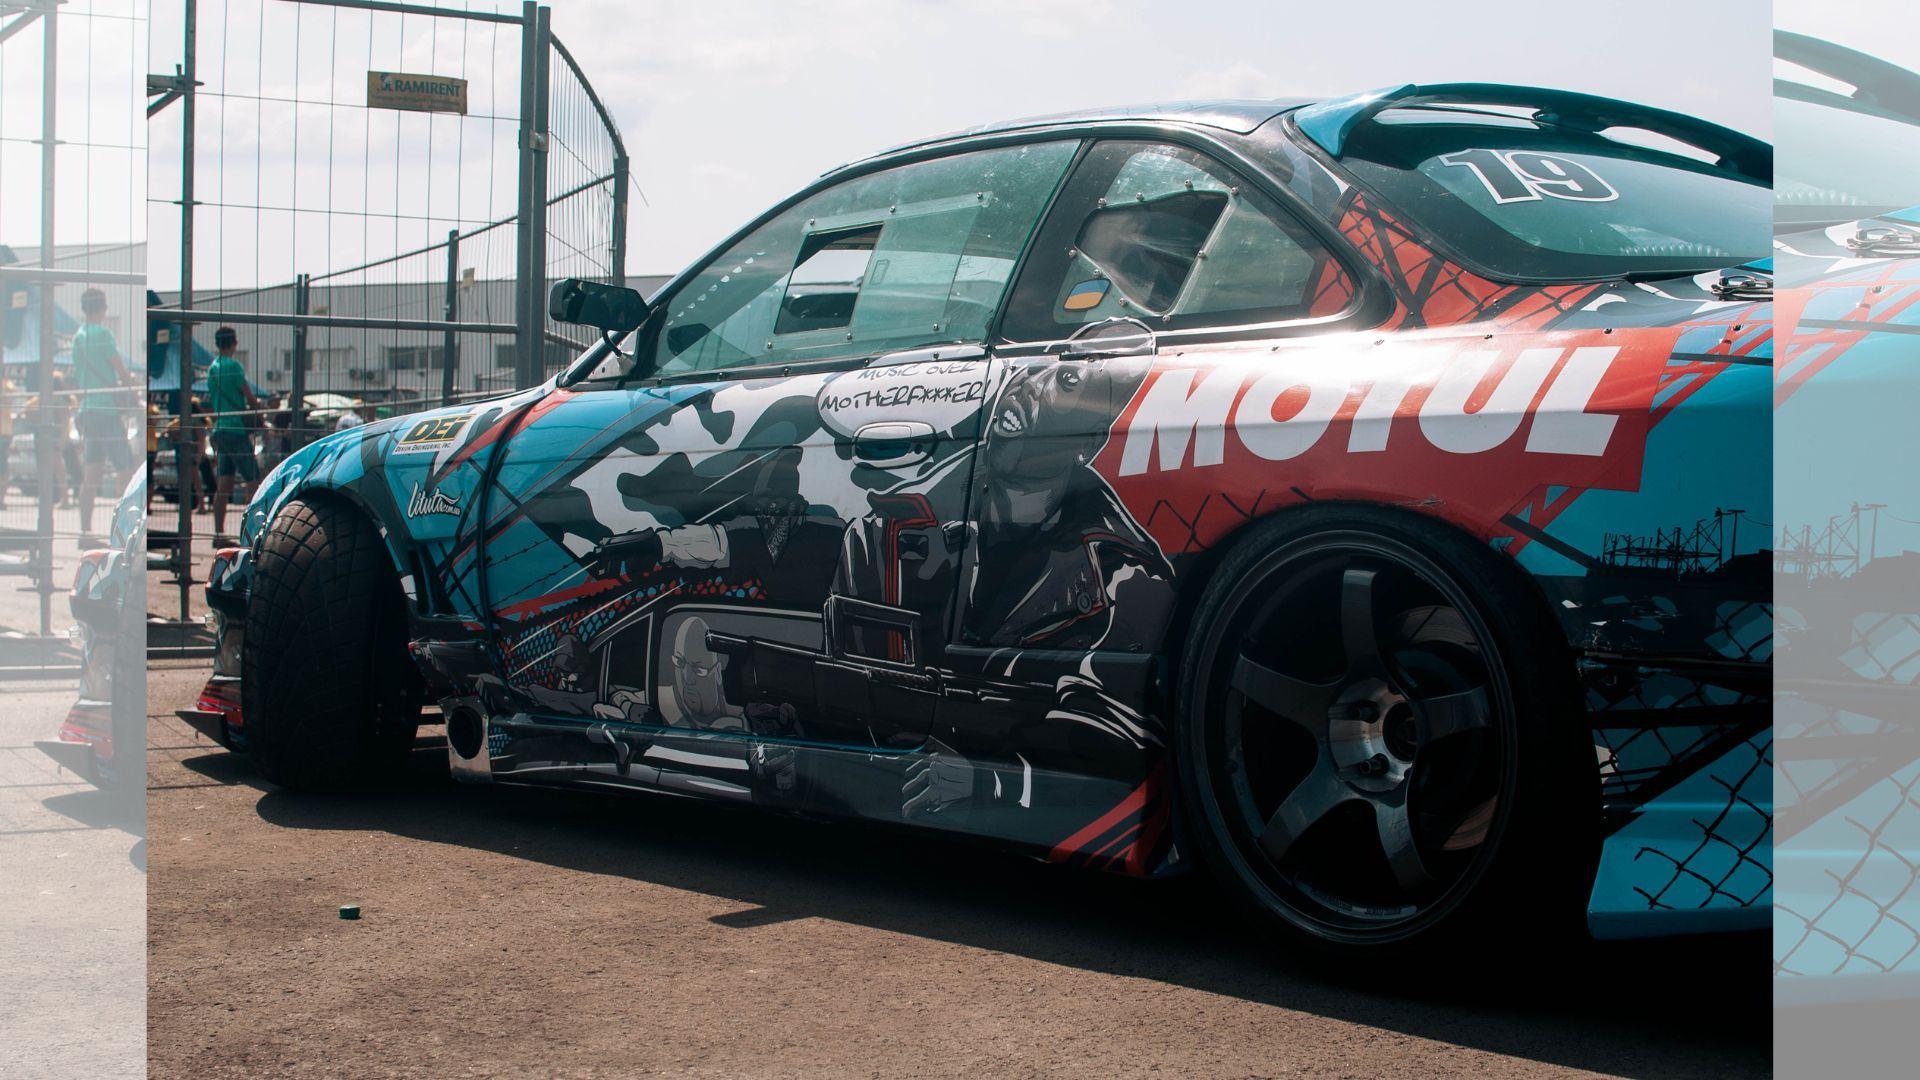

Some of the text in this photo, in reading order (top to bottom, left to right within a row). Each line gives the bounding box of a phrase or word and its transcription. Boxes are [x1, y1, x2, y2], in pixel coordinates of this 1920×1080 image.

[394, 80, 461, 97] RAMIRENT
[1438, 148, 1620, 205] 19
[857, 362, 977, 381] MUSIC OVER
[1118, 345, 1622, 477] MOTUL
